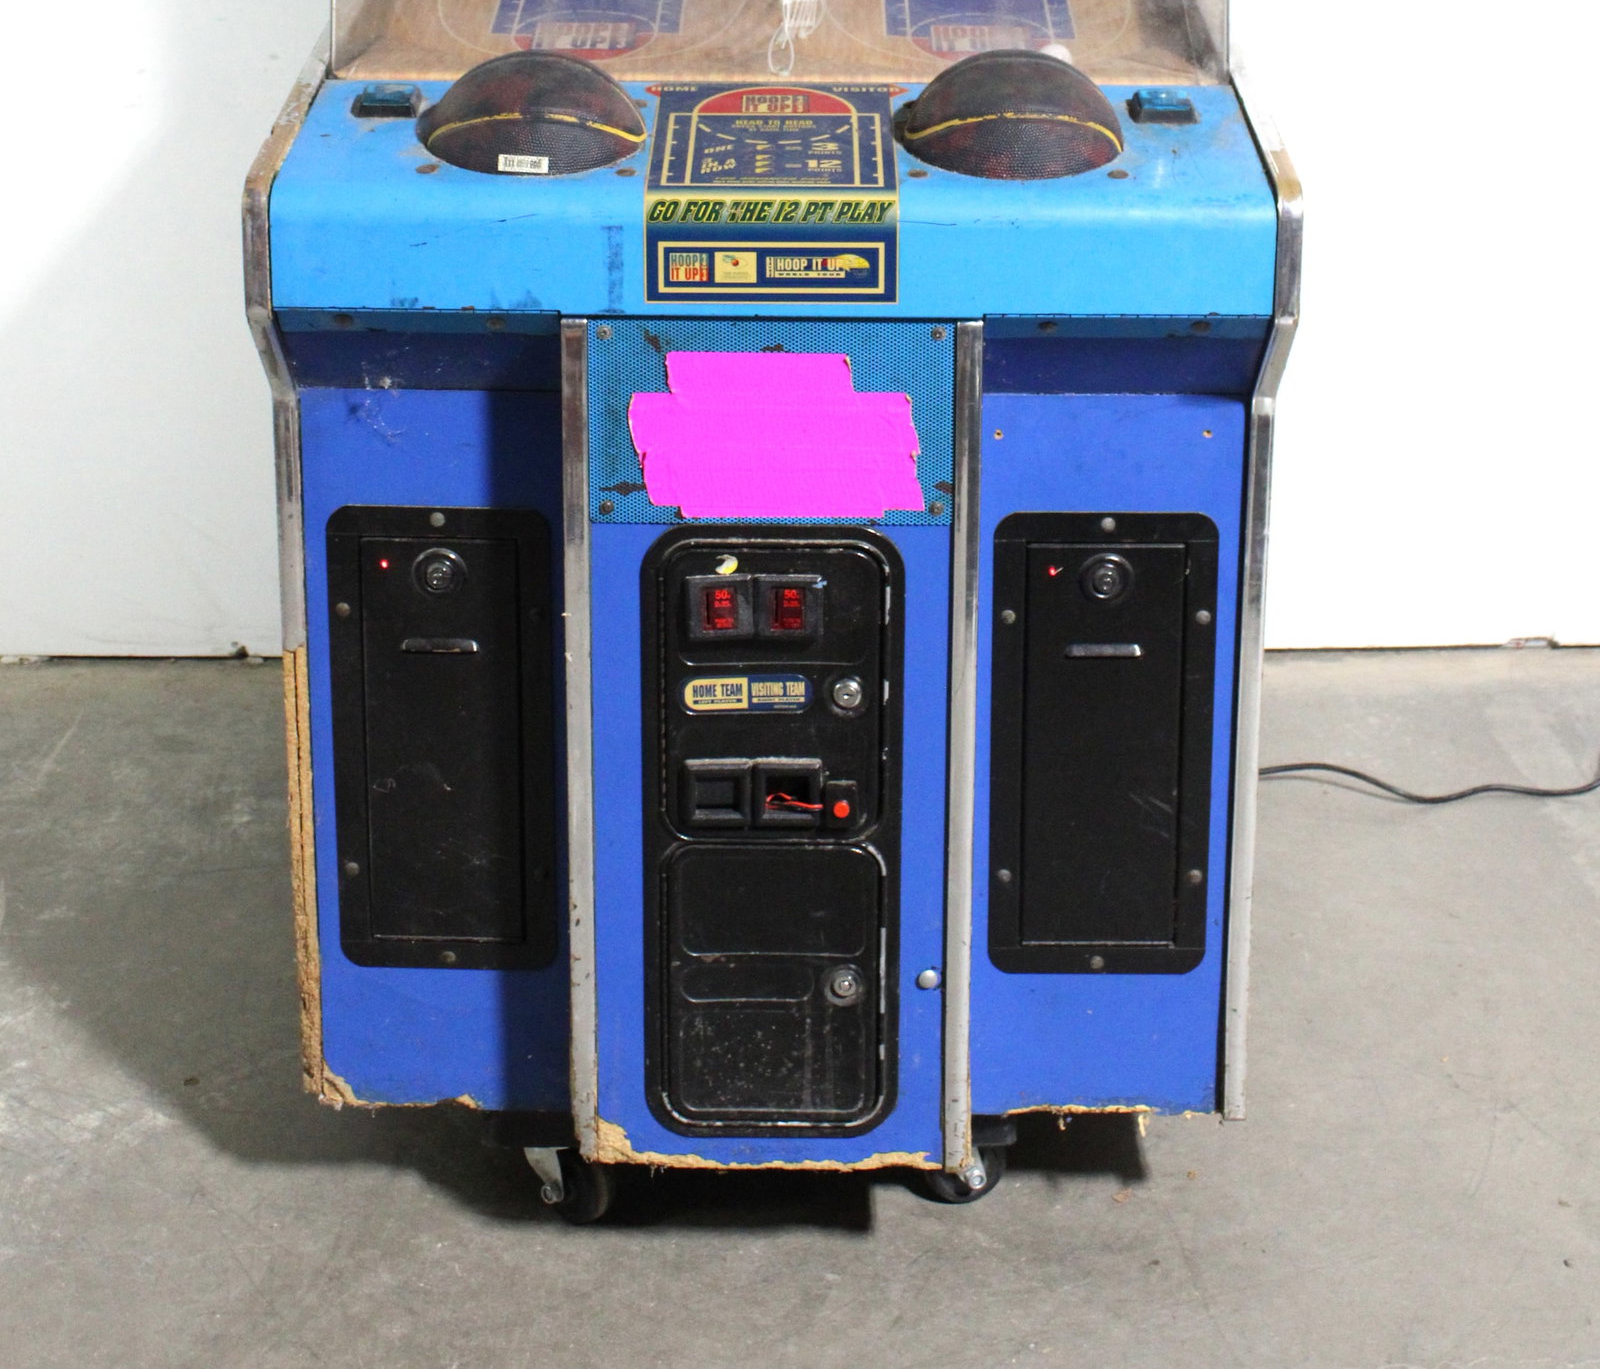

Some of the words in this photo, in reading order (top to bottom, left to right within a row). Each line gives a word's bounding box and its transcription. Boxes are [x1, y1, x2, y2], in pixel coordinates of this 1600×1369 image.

[811, 142, 839, 150] 3
[804, 160, 842, 168] 12
[648, 199, 681, 223] GO
[678, 199, 726, 223] FOR
[727, 199, 776, 223] THE
[771, 198, 802, 223] 12
[799, 199, 838, 224] PT
[832, 199, 895, 224] PLAY
[670, 254, 698, 267] HOOP
[777, 258, 808, 270] HOOP
[812, 258, 823, 270] IT
[670, 267, 681, 280] IT
[685, 267, 699, 280] UP
[693, 684, 717, 698] HOME
[720, 683, 743, 697] TEAM
[751, 682, 784, 696] VISITING
[786, 681, 805, 696] TEAM
